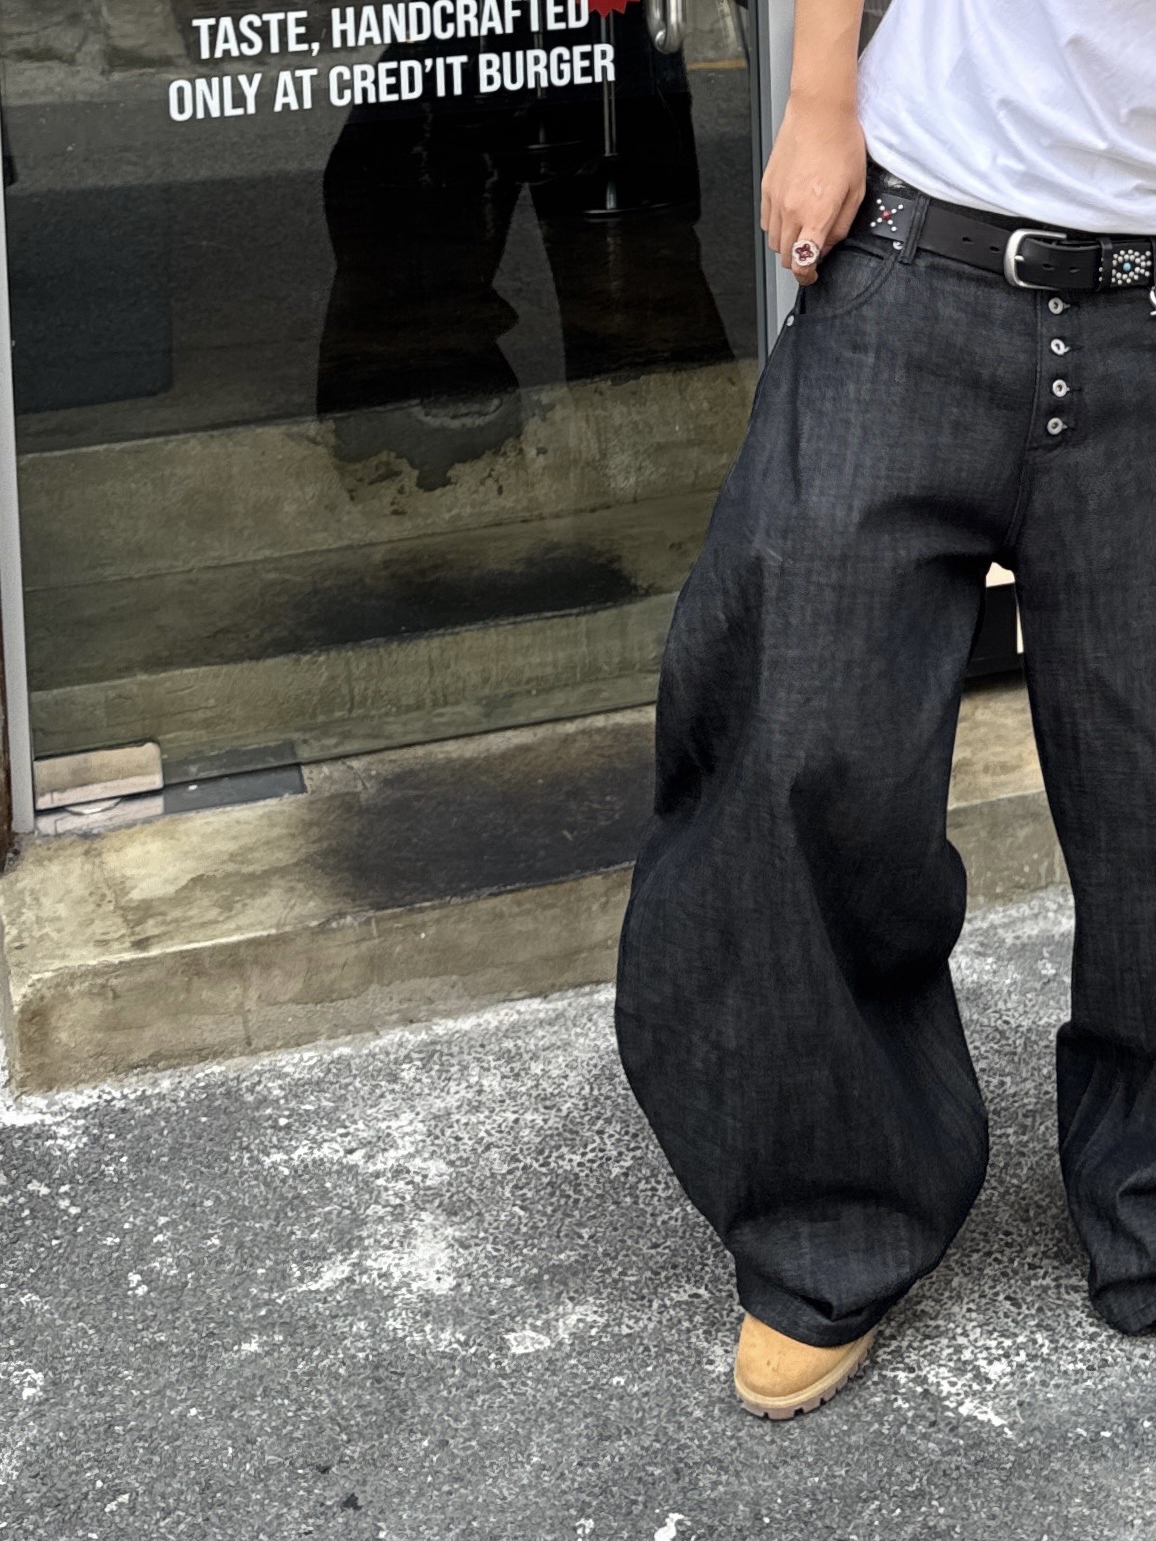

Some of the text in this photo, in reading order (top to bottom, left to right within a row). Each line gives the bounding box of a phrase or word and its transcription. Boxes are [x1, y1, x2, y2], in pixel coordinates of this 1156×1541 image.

[191, 12, 320, 60] TASTE,
[168, 43, 616, 122] ONLY AT CRED'IT BURGER
